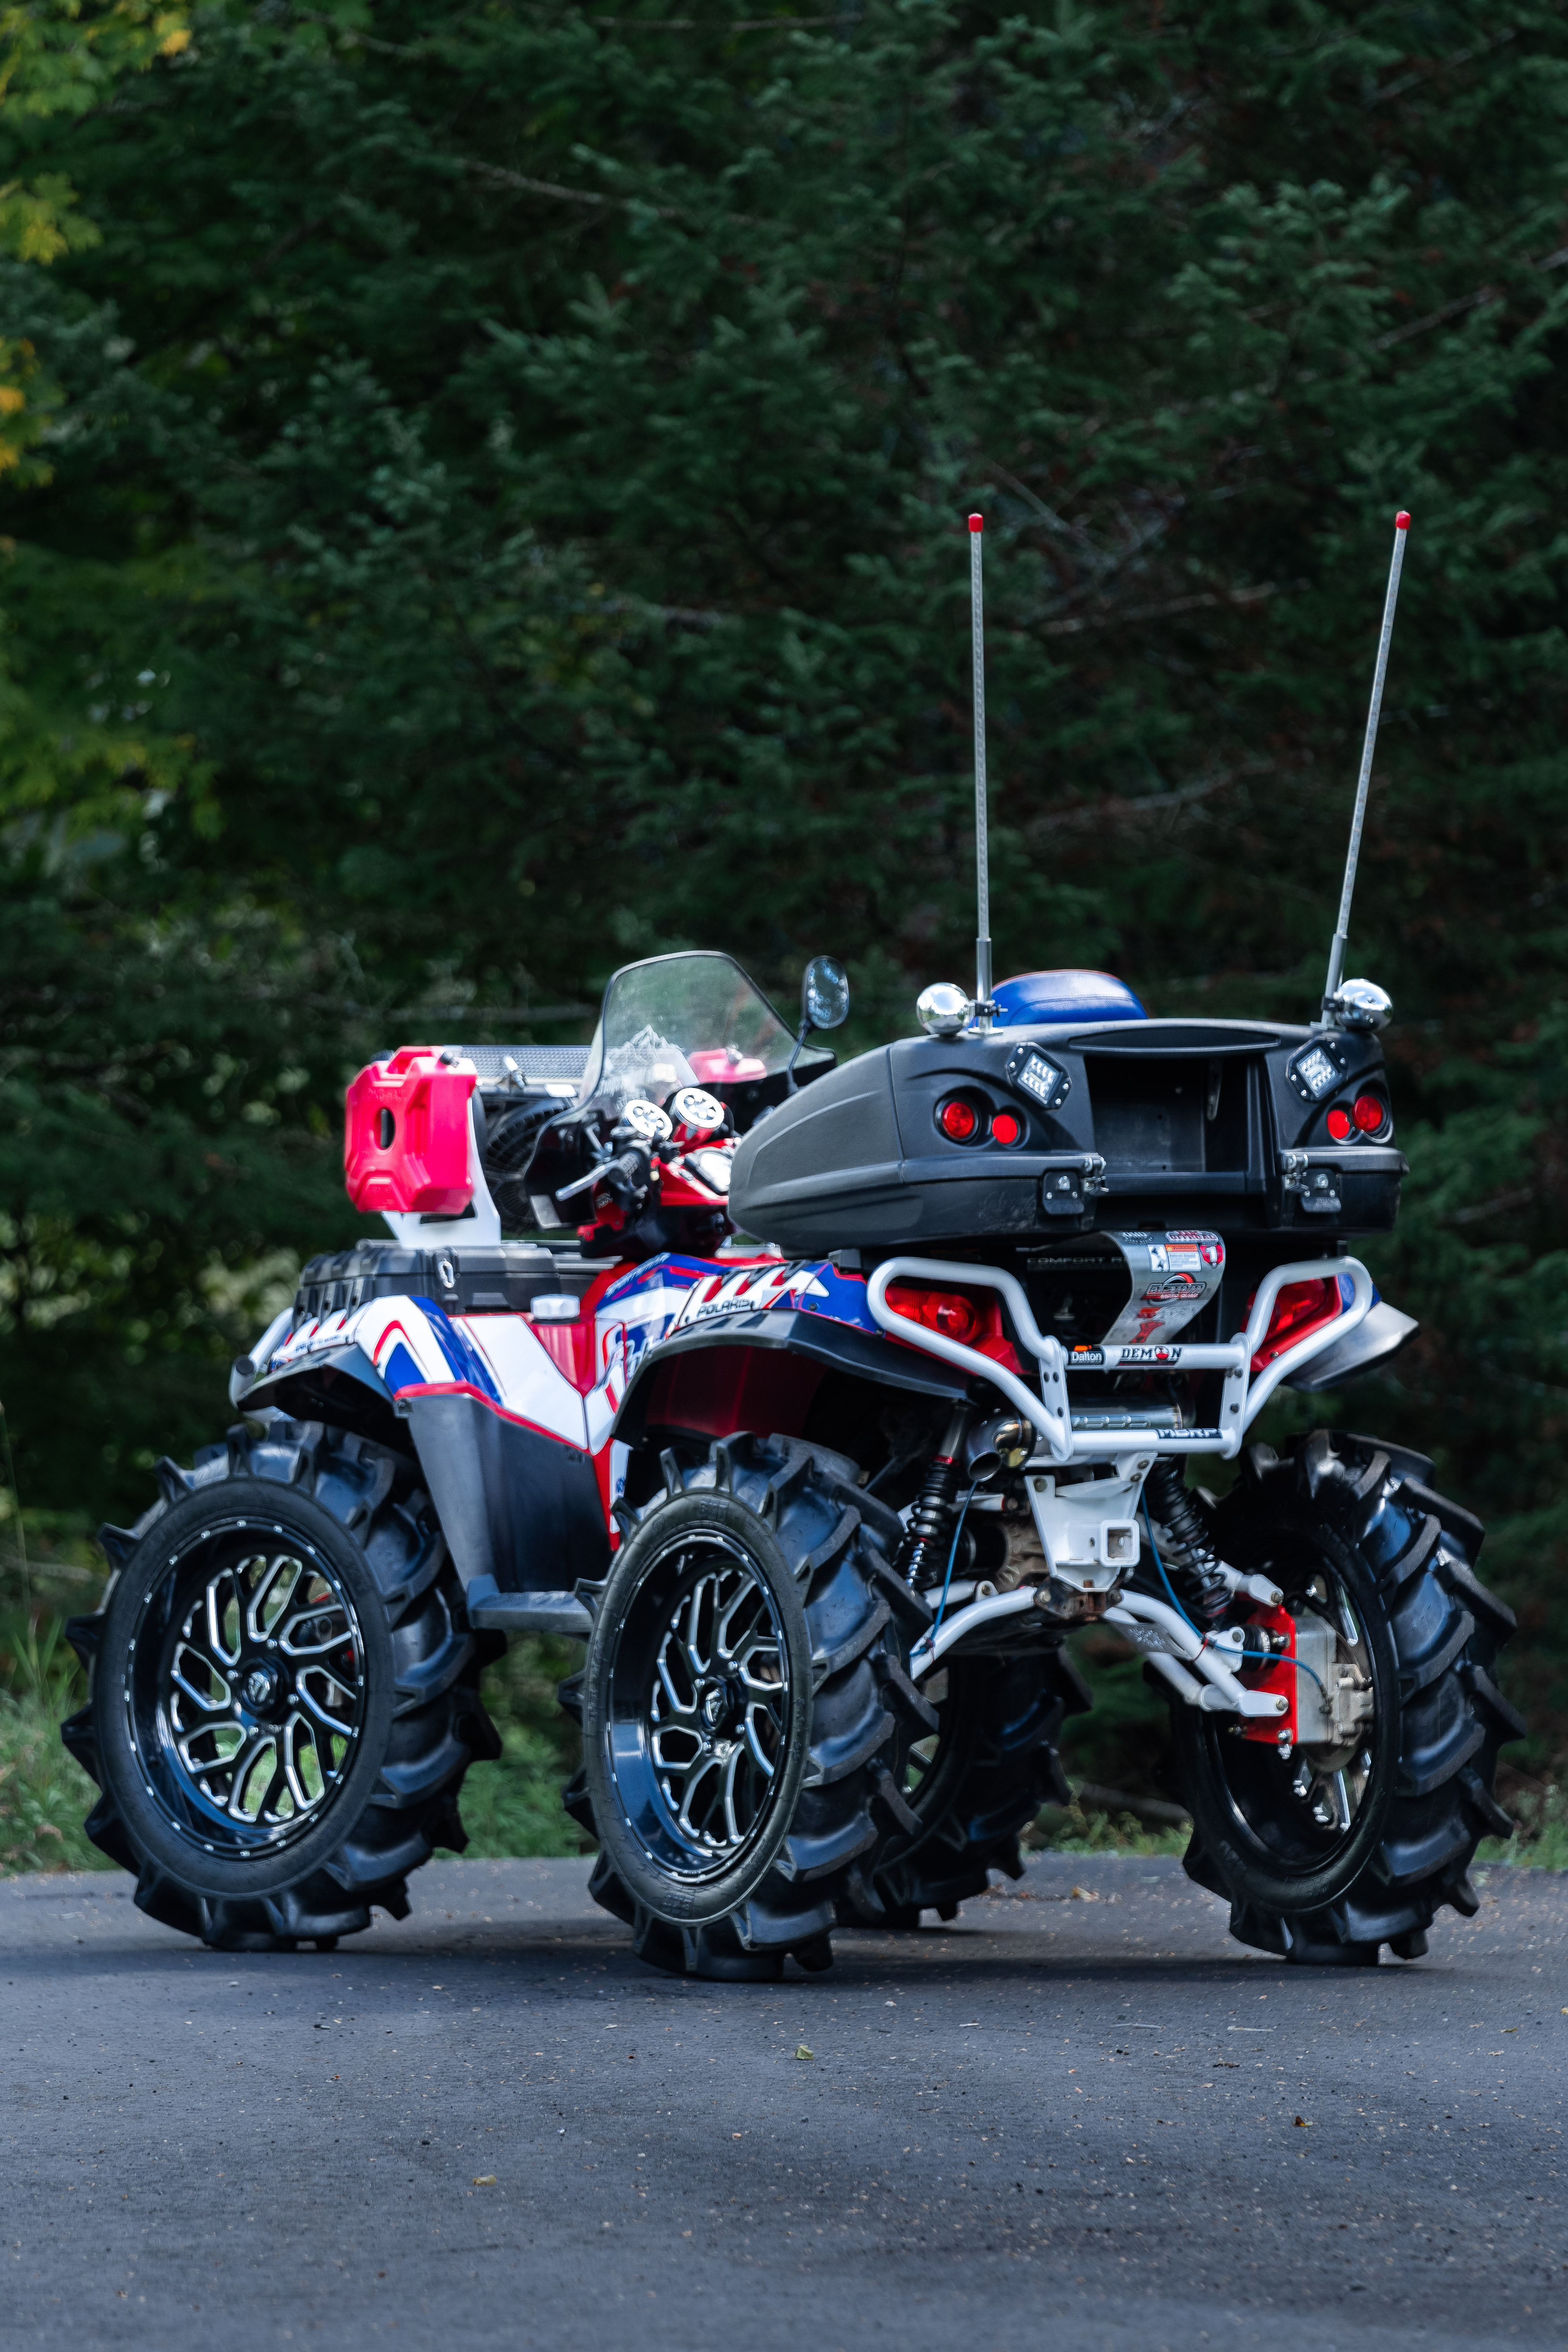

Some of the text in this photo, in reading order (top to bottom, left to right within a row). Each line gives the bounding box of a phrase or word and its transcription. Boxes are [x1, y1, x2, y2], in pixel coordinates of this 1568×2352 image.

[1205, 1245, 1217, 1262] 1
[696, 1299, 750, 1317] POLARIS
[1072, 1351, 1102, 1361] Dalton
[1158, 1428, 1217, 1438] MBRP
